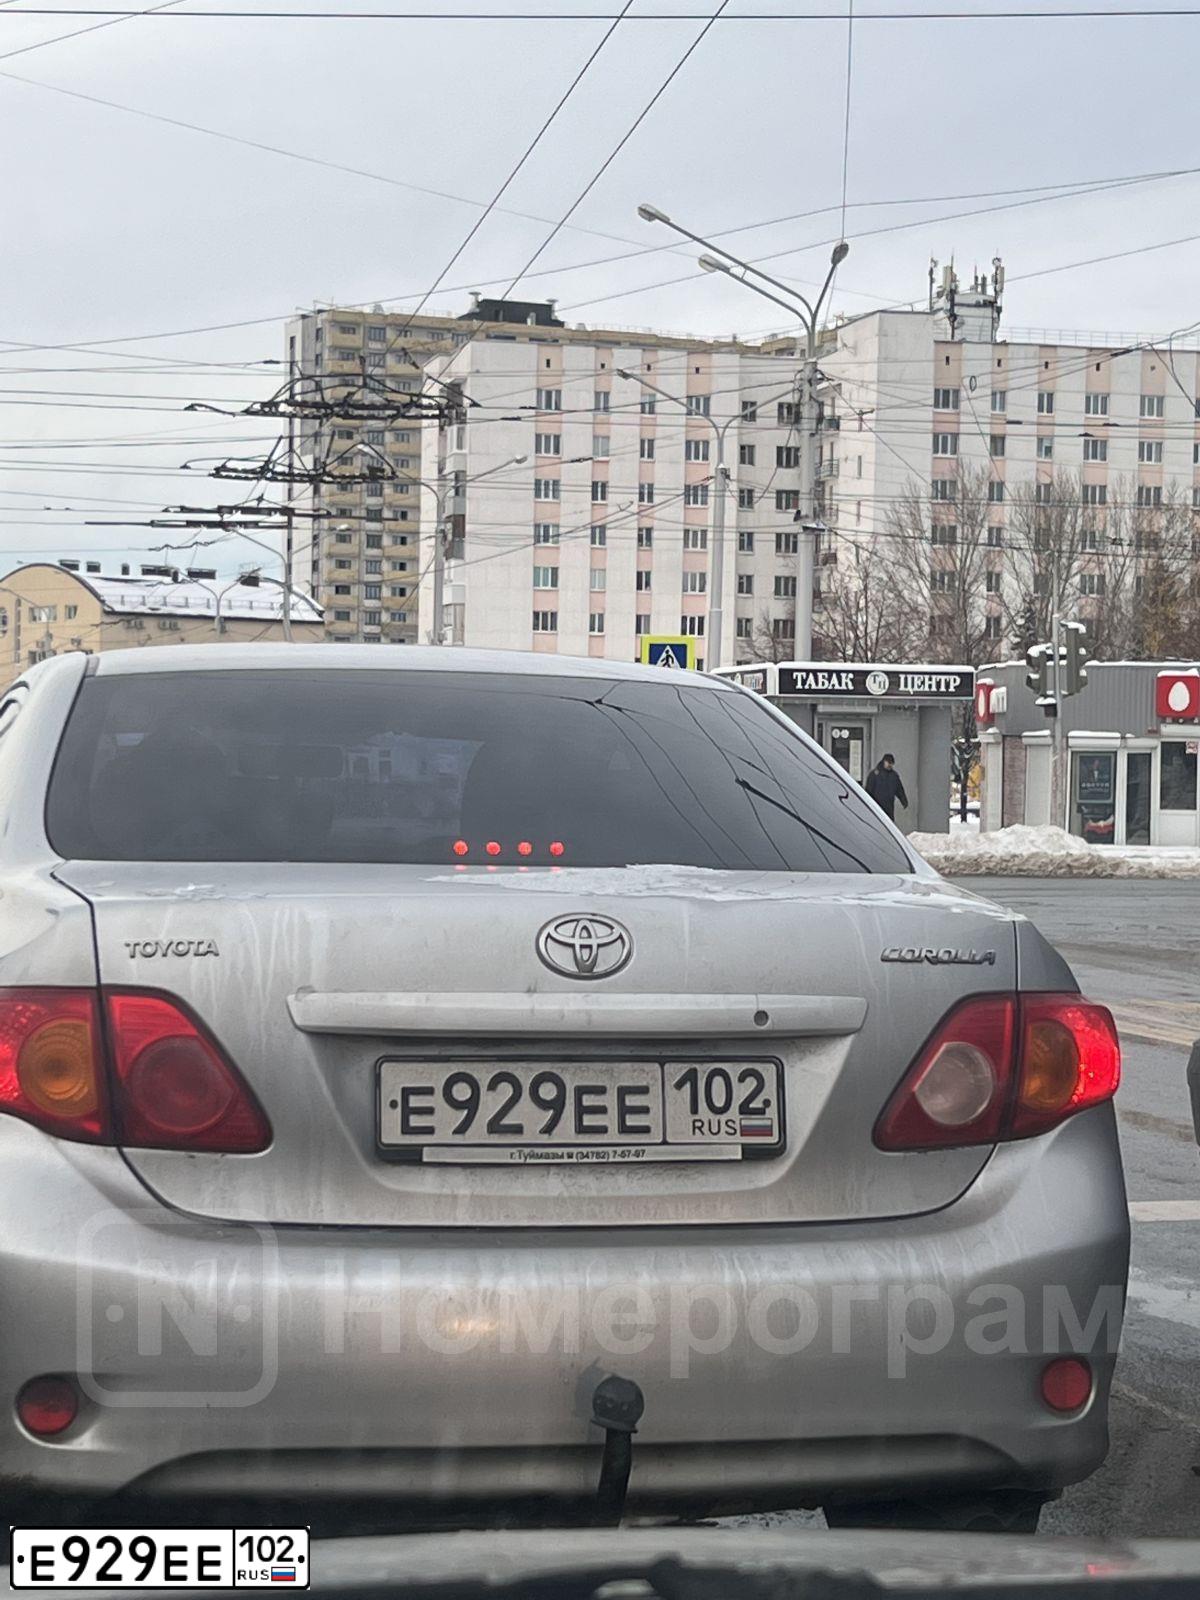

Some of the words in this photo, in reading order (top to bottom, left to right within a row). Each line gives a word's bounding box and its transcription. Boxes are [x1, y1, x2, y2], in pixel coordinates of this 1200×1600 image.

[793, 672, 854, 690] ТАБАК
[899, 674, 961, 694] ЦЕНТР
[124, 939, 220, 959] TOYOTA
[880, 947, 996, 966] COROLLA
[672, 1067, 766, 1115] 102
[692, 1118, 738, 1136] RUS
